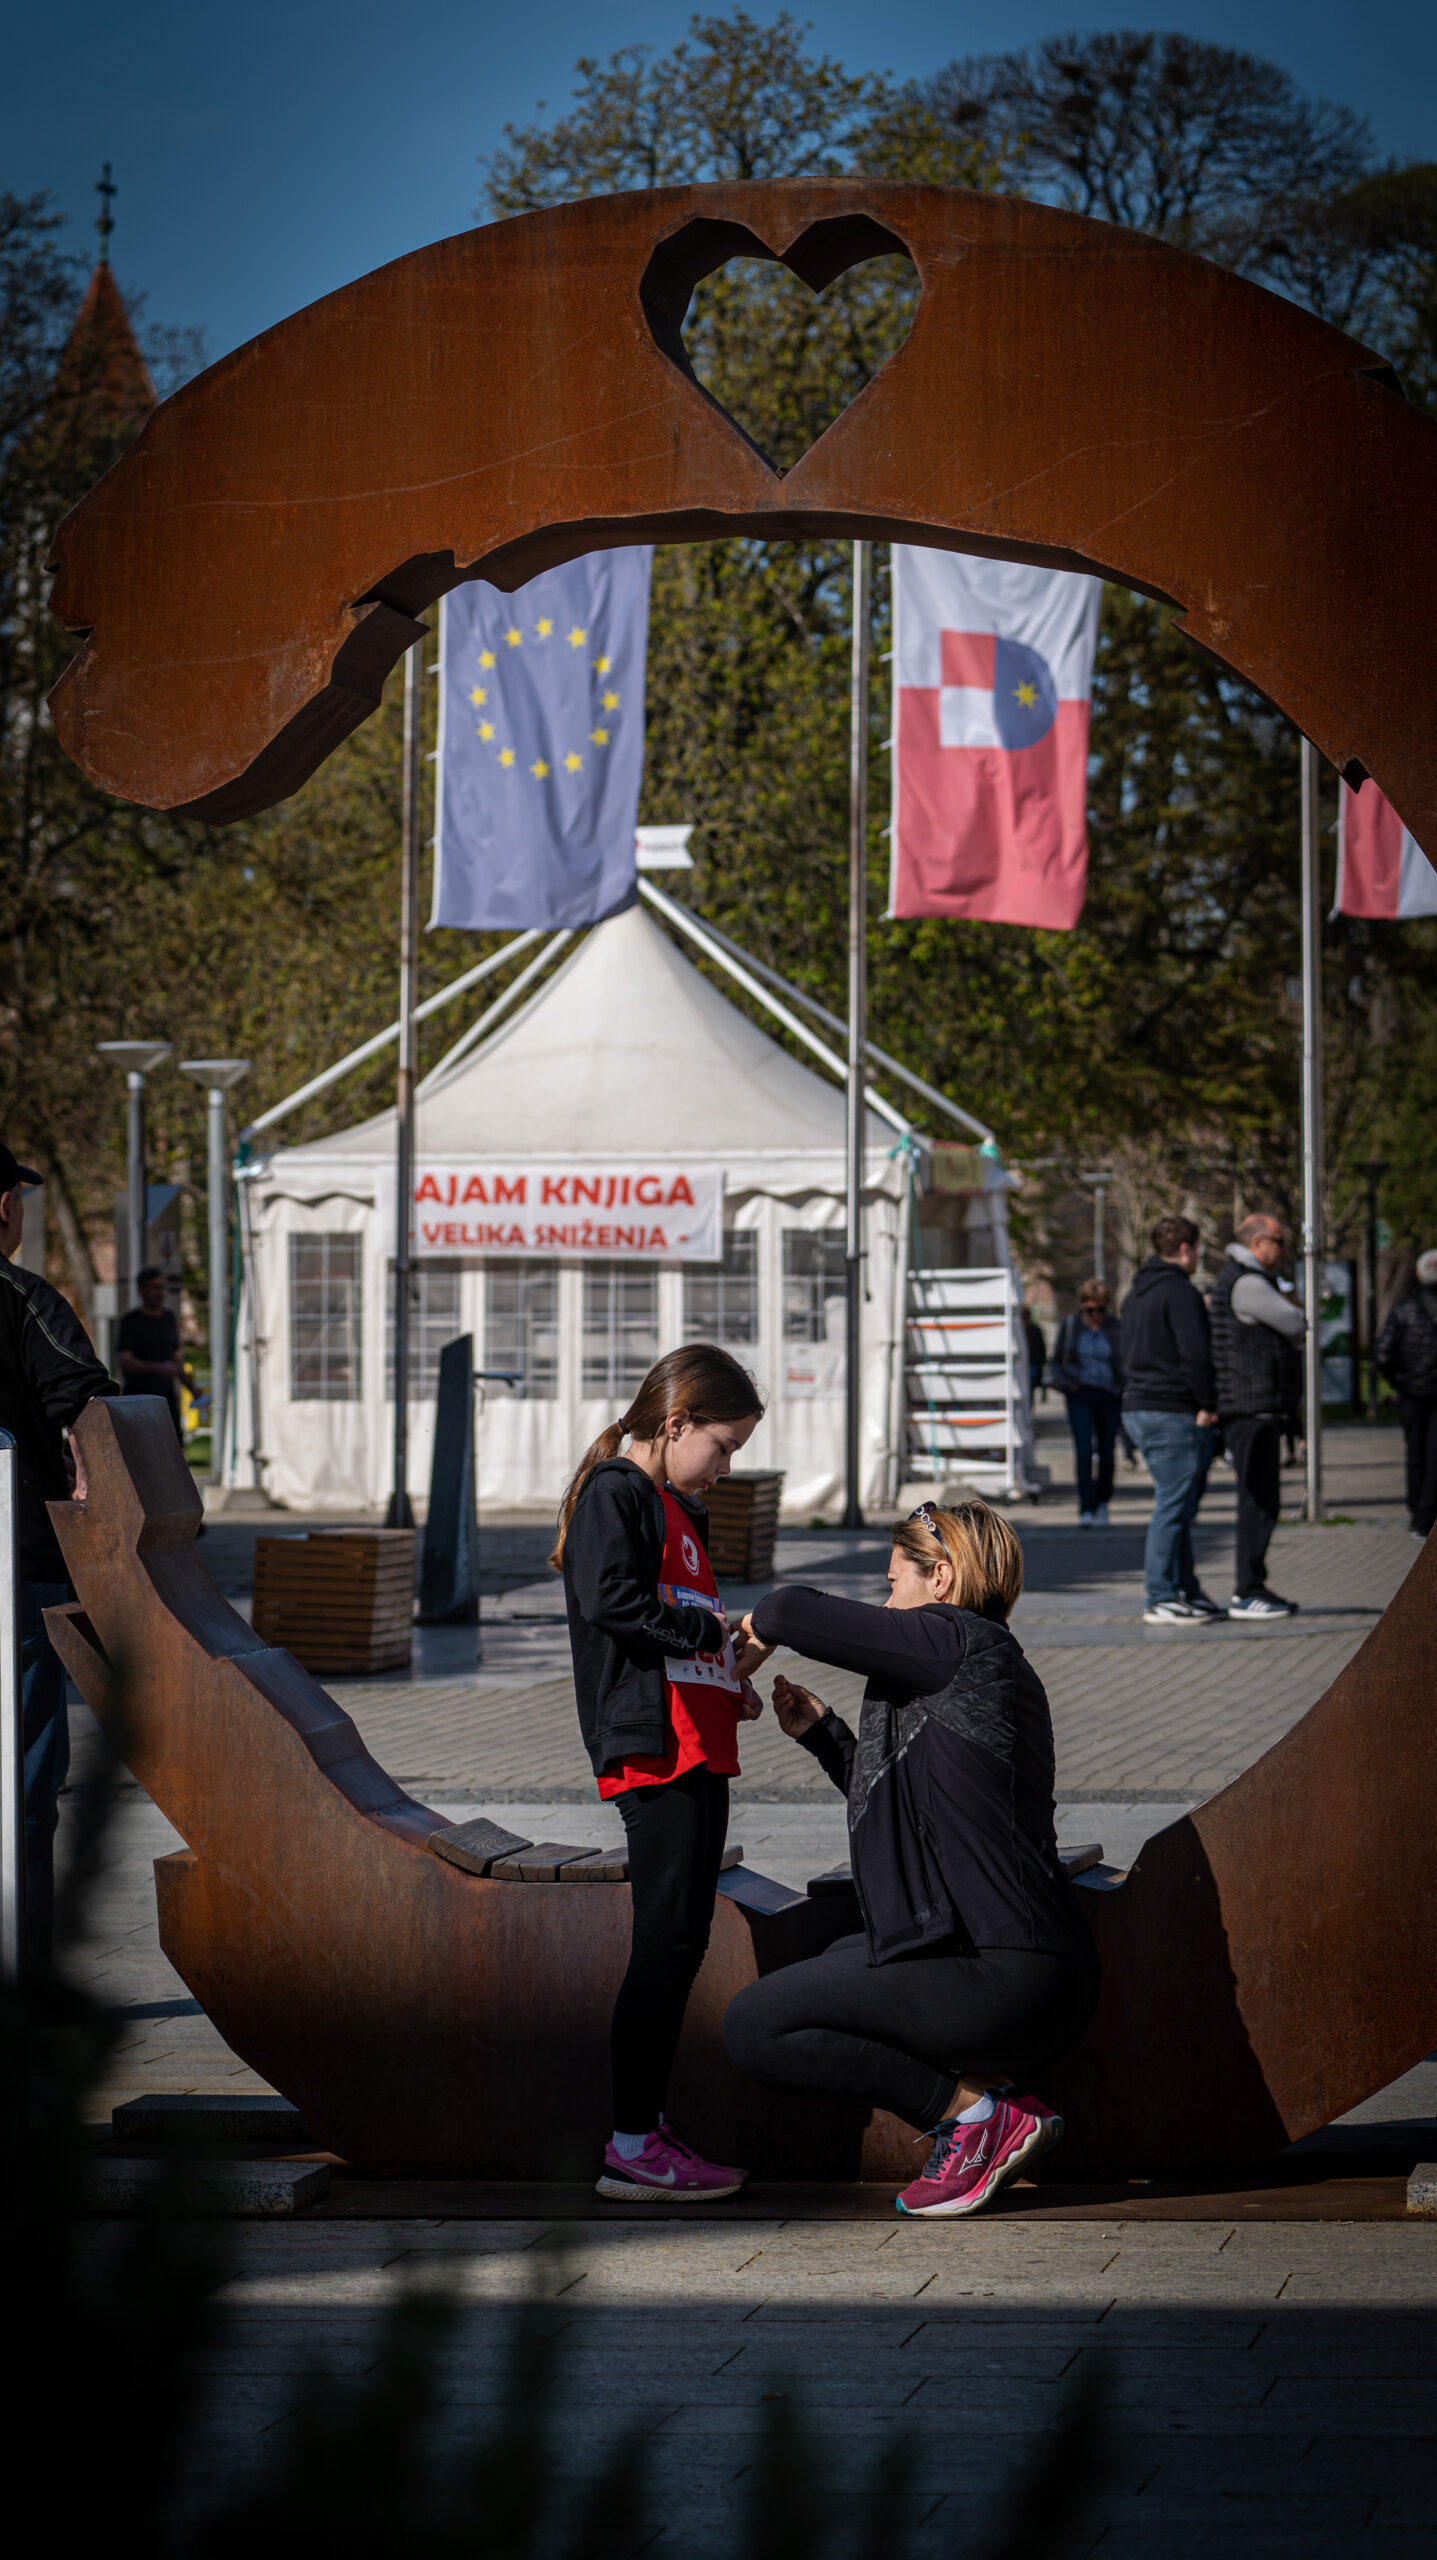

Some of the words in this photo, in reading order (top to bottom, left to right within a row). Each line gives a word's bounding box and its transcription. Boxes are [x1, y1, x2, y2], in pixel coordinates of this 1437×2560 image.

[413, 1174, 528, 1208] AJAM
[541, 1175, 696, 1209] KNJIGA
[422, 1221, 526, 1246] VELIKA
[534, 1218, 669, 1250] SNIŽENJA
